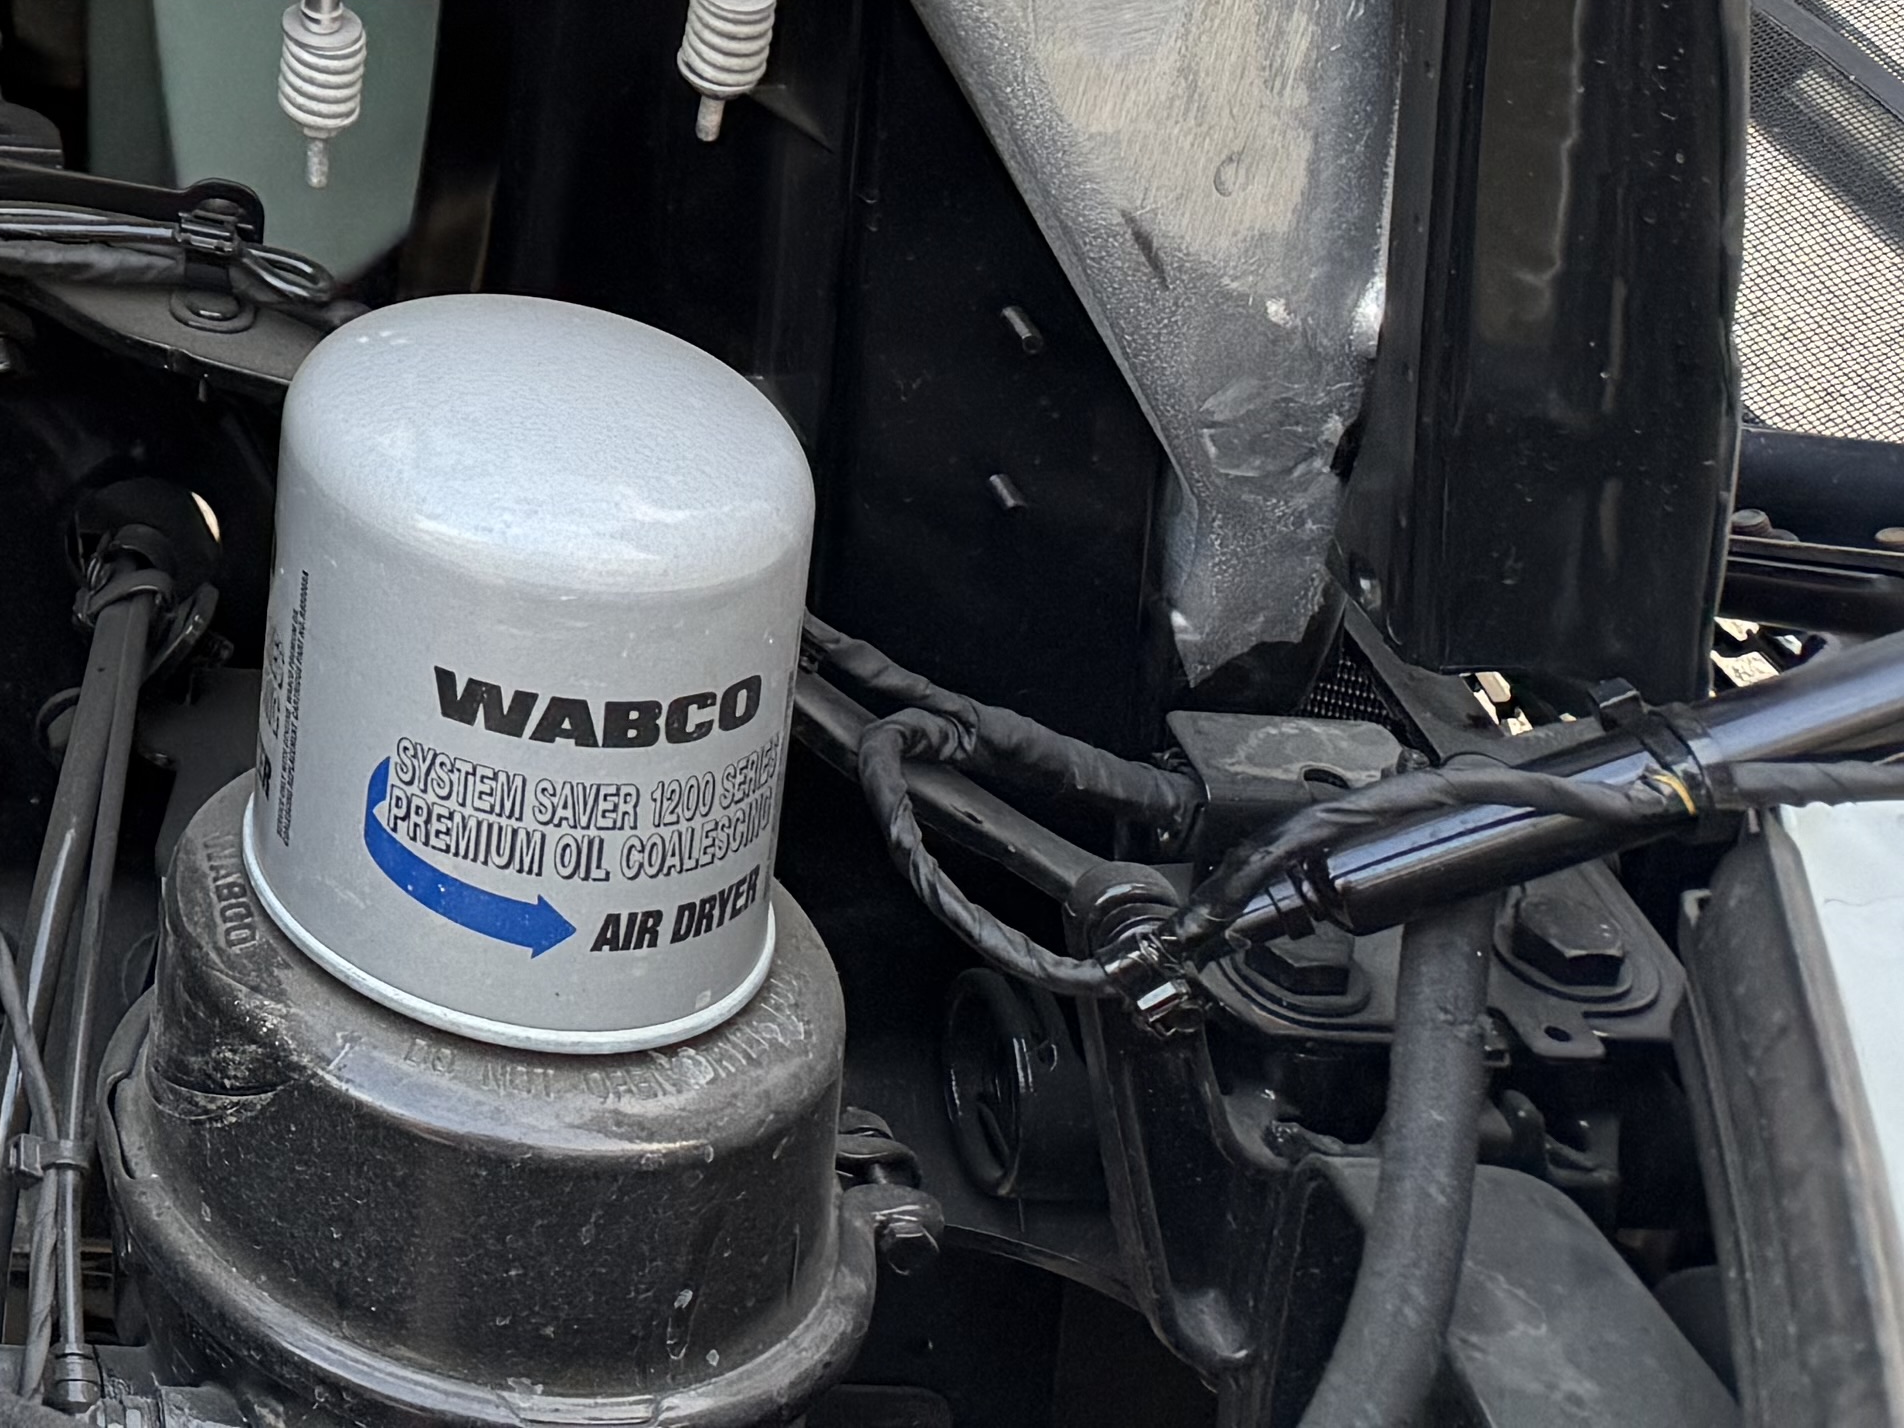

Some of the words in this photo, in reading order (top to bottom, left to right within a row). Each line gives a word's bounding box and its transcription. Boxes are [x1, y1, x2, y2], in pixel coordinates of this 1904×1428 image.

[432, 665, 762, 748] WABCO
[395, 736, 525, 822] SYSTEM
[532, 781, 640, 832] SAVER
[651, 771, 712, 829] 1200
[387, 793, 544, 877] PREMIUM
[553, 834, 610, 882] OIL
[620, 784, 775, 879] COALESCING
[202, 834, 257, 952] WABCO
[590, 909, 661, 953] AIR
[670, 863, 761, 946] DRYER
